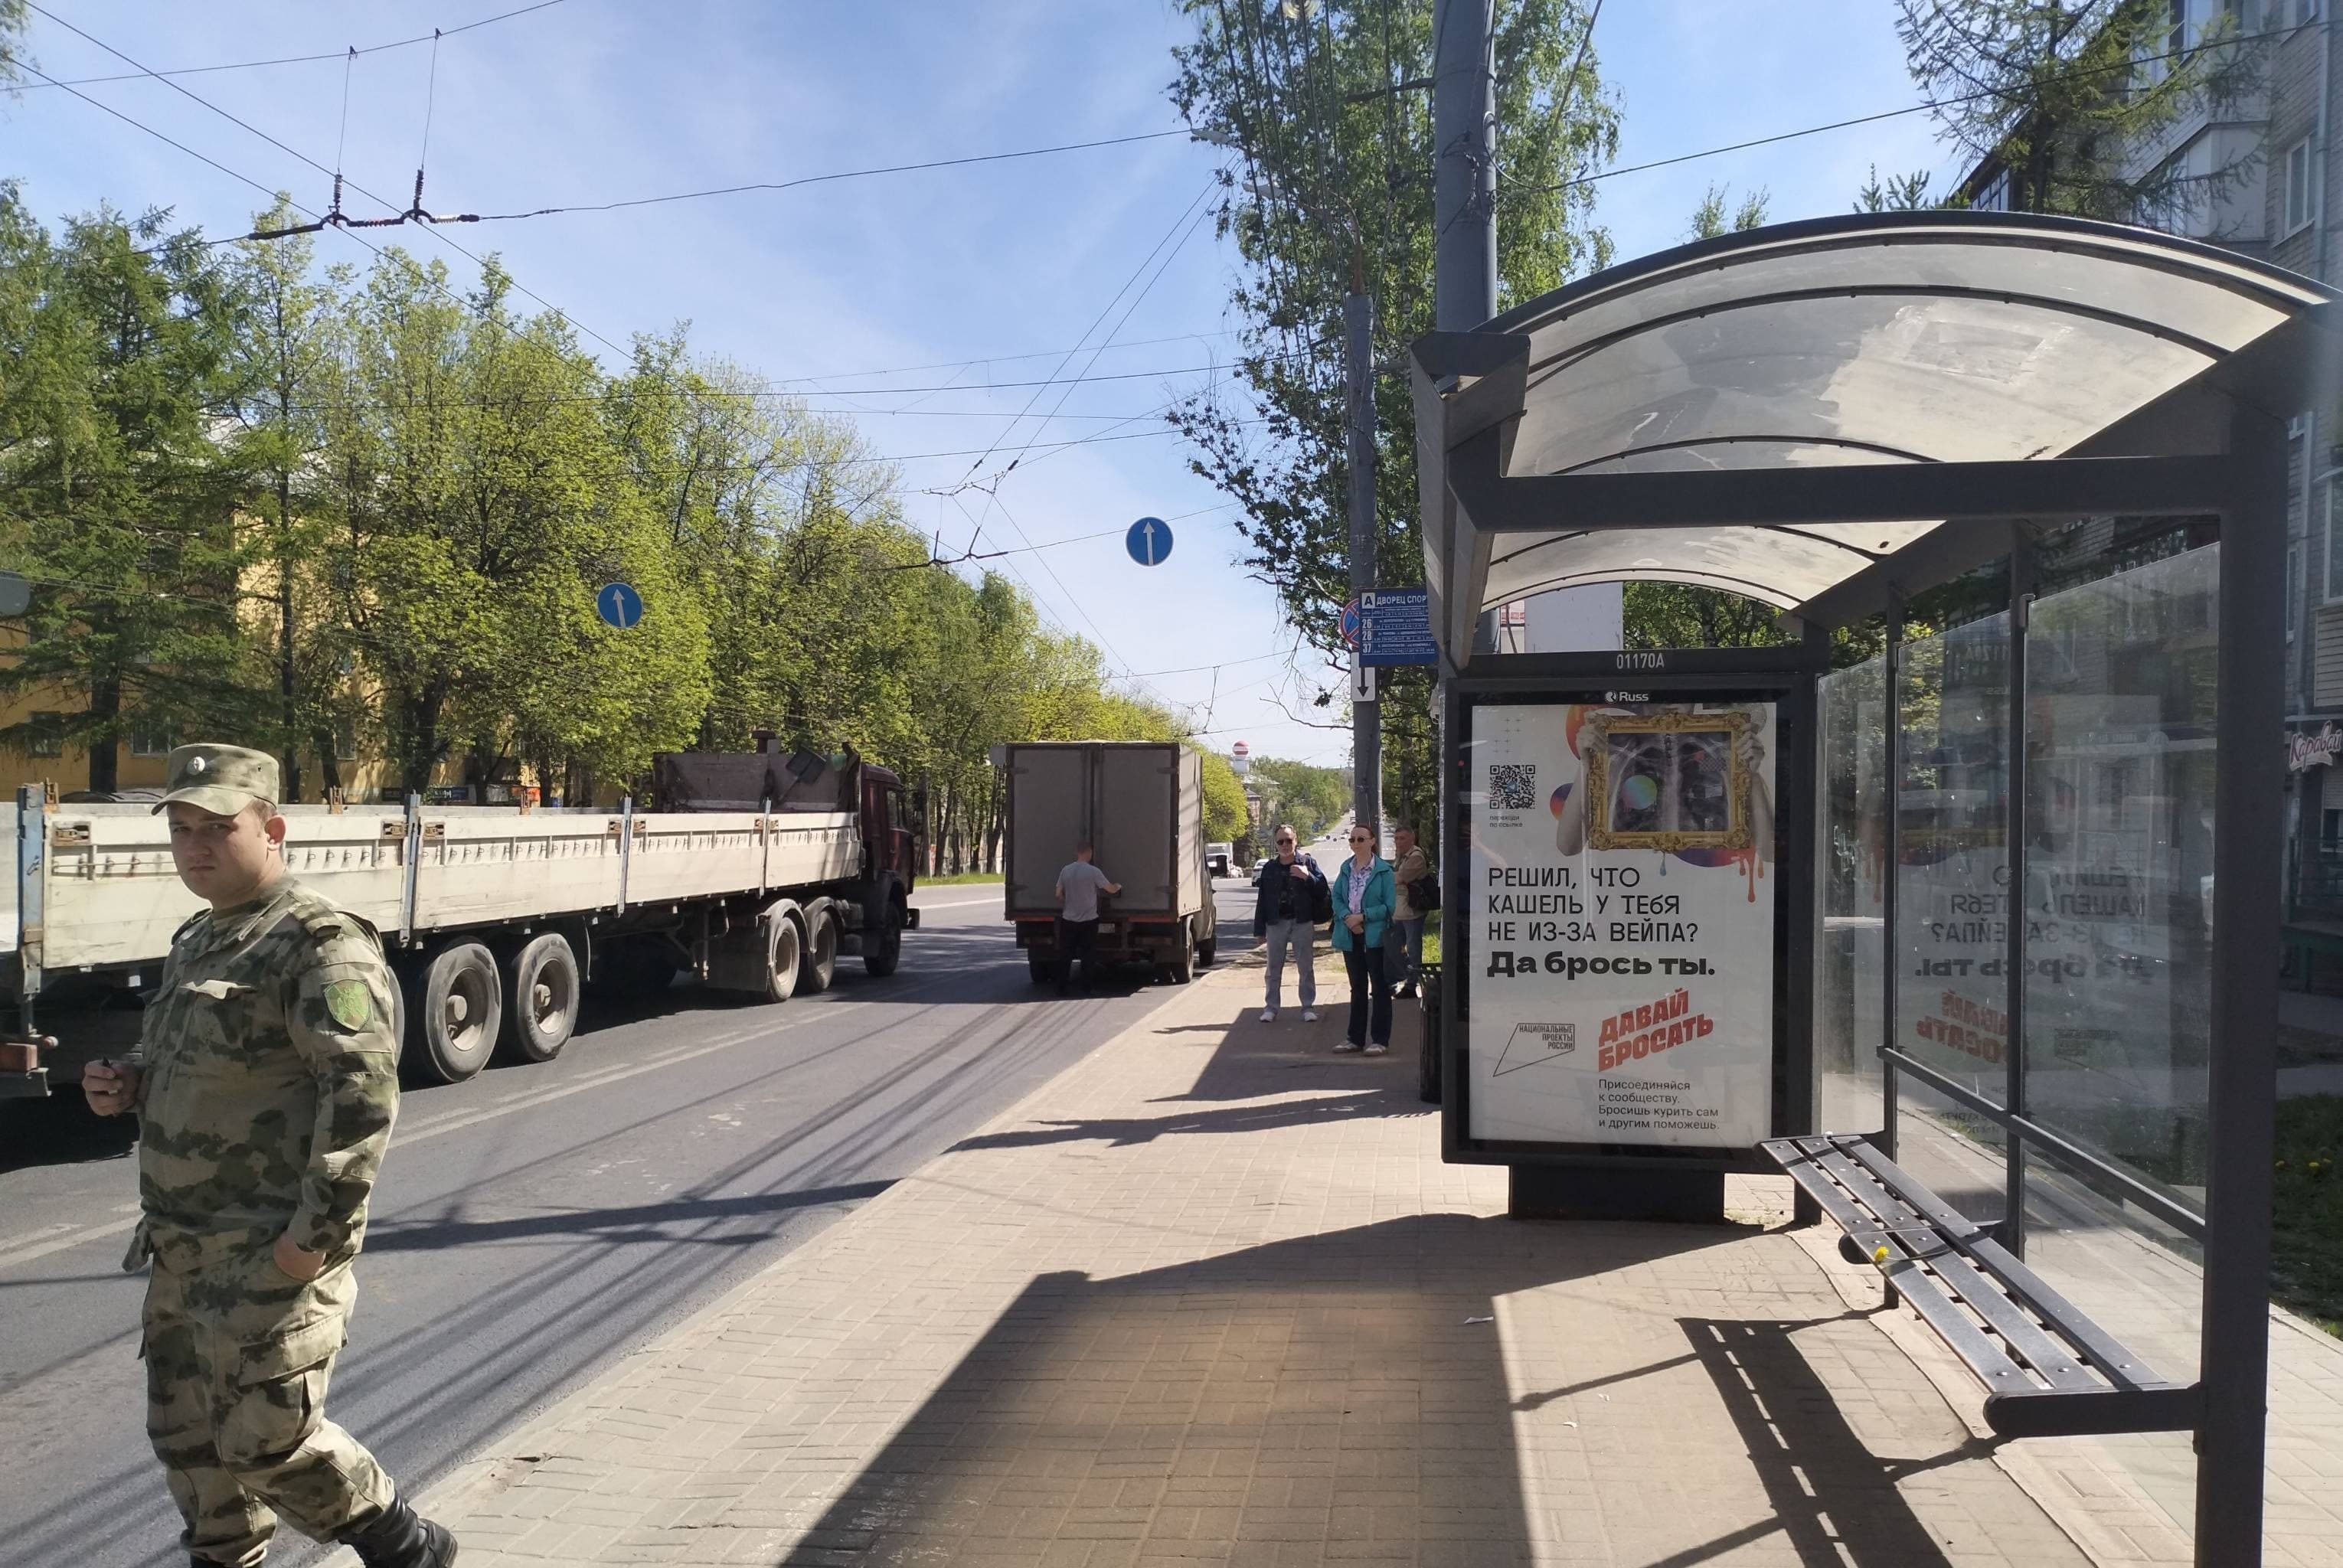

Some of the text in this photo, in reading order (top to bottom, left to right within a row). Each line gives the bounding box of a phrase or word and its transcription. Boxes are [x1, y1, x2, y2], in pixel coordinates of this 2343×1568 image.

[1376, 595, 1406, 606] ДВОРЕЦ
[1407, 595, 1428, 604] СПОР
[1362, 619, 1372, 629] 26
[1362, 630, 1372, 641] 28
[1362, 643, 1372, 653] 37
[1619, 691, 1649, 702] Russ
[2290, 720, 2341, 771] Каравай
[1488, 867, 1640, 889] РЕШИЛ, ЧТО
[1488, 894, 1583, 914] КАШЕЛЬ
[1596, 895, 1609, 914] У
[1488, 917, 1698, 942] НЕ ИЗ-ЗА ВЕЙПА?
[1487, 951, 1715, 981] Да брось ты.
[1598, 987, 1689, 1047] ДАВАЙ
[1519, 1024, 1573, 1034] НАЦИОНАЛЬНЫЕ
[1542, 1033, 1573, 1042] ПРОЕКТЫ
[1598, 1013, 1714, 1072] БРОСАТЬ
[1547, 1041, 1573, 1050] РОССИИ
[1598, 1079, 1691, 1092] Присоединяйся
[1598, 1093, 1680, 1103] к сообществу.
[1598, 1104, 1719, 1118] Бросишь курить сам
[1608, 1119, 1650, 1130] другим
[1653, 1120, 1720, 1130] поможешь.
